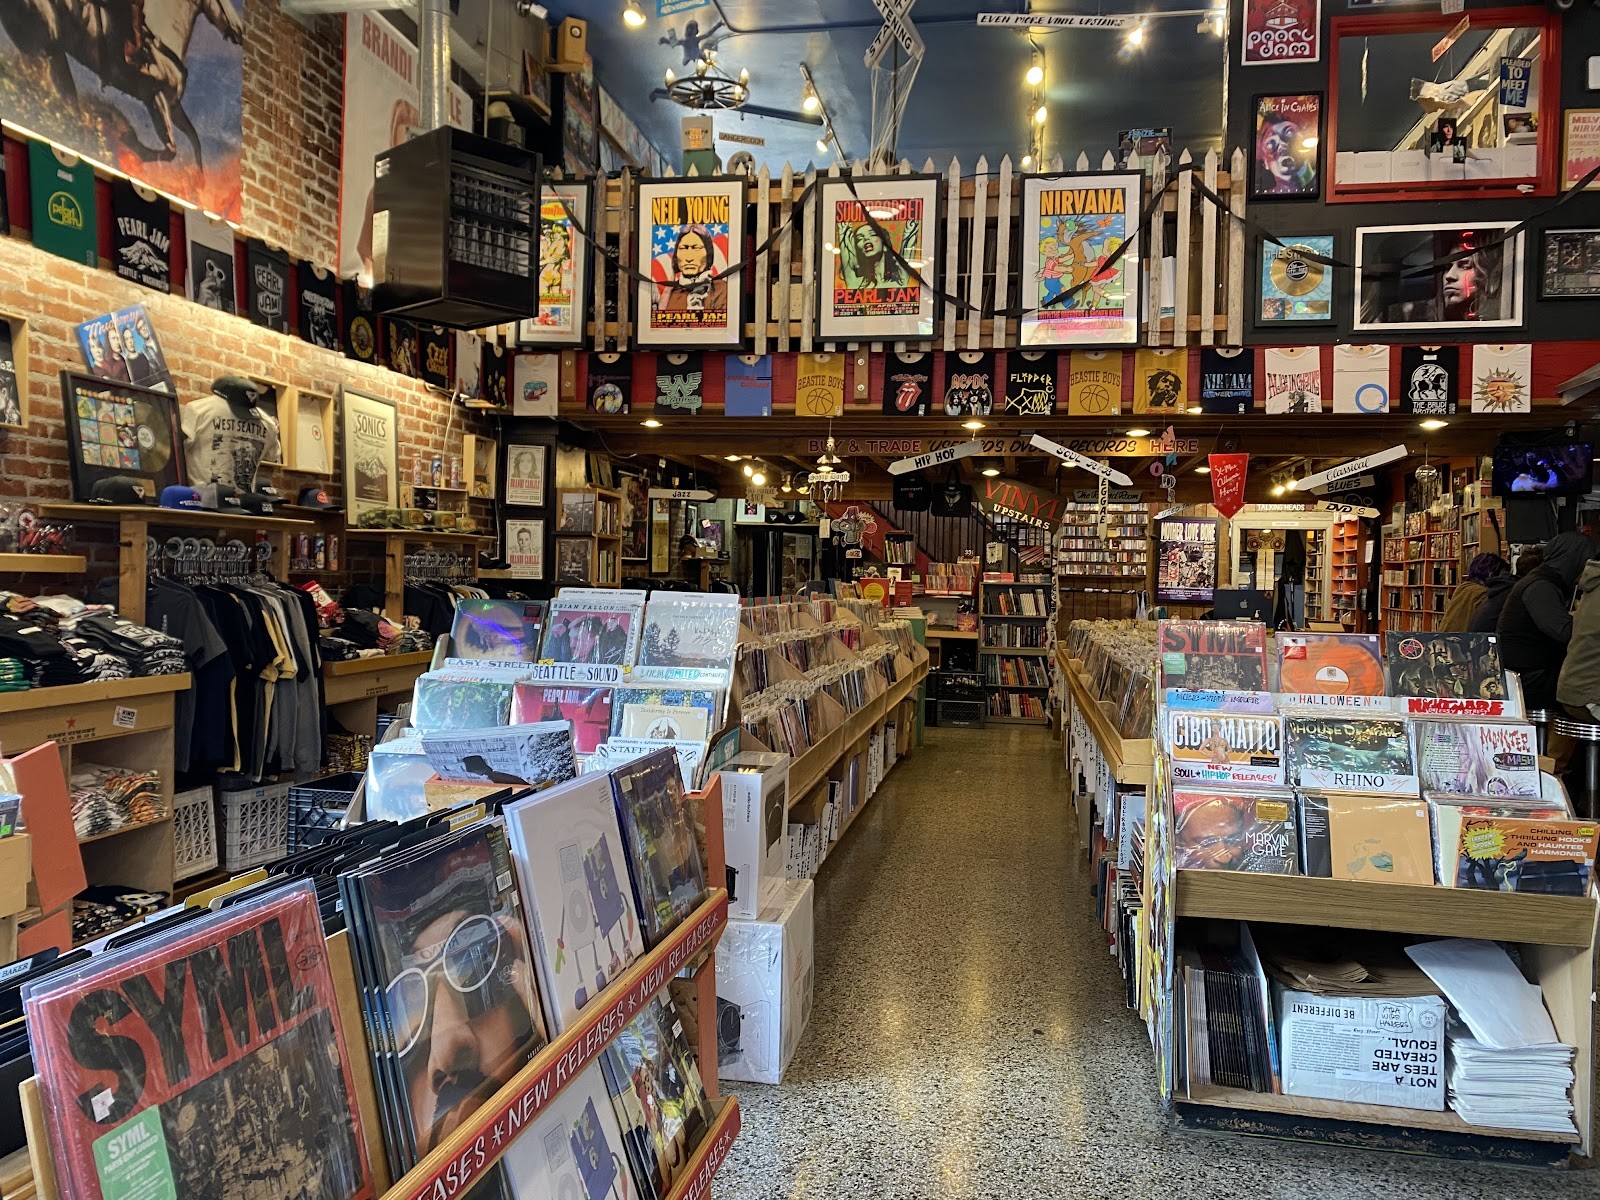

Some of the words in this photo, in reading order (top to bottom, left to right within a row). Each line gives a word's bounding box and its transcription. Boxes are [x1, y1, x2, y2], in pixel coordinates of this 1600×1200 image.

[1014, 16, 1044, 24] MORE
[1048, 17, 1075, 25] VINYL
[1078, 18, 1126, 26] UPSTAIRS
[362, 13, 412, 85] BRANDI
[1508, 66, 1523, 80] TO
[1502, 80, 1526, 90] MEET
[1505, 90, 1524, 104] ME
[1041, 188, 1124, 214] NIRVANA
[652, 198, 681, 225] NEIL
[686, 196, 729, 225] YOUNG
[117, 216, 148, 241] PEARL
[150, 228, 170, 253] JAM
[256, 267, 282, 292] PEARL
[259, 296, 280, 311] JAM
[834, 288, 882, 304] PEARL
[886, 287, 920, 302] JAM
[798, 375, 826, 391] BEASTIE
[828, 374, 845, 391] BOYS
[952, 374, 988, 390] AC/DC
[1010, 372, 1052, 386] FLIPPER
[1070, 370, 1100, 386] BEASTIE
[1102, 370, 1121, 386] BOYS
[1204, 374, 1252, 390] NIRVANA
[212, 418, 235, 431] WEST
[236, 418, 268, 439] SEATTLE
[356, 413, 386, 438] SONICS
[850, 440, 861, 453] &
[866, 440, 922, 453] TRADE
[1069, 440, 1138, 454] RECORDS
[1150, 438, 1199, 454] HERE
[914, 456, 931, 468] HIP
[936, 448, 955, 463] HOP
[1056, 446, 1081, 463] SOUL
[1326, 457, 1370, 482] Classical
[1216, 472, 1240, 487] Albums
[1327, 478, 1362, 492] BLUES
[1100, 460, 1108, 524] EGGAE
[984, 479, 1064, 523] VINYL
[1326, 502, 1366, 516] DVD'S
[992, 504, 1050, 530] UPSTAIRS
[1184, 522, 1200, 540] LOVE
[1164, 626, 1256, 653] SYML
[448, 659, 482, 667] EASY
[490, 660, 532, 670] STREET
[532, 665, 576, 681] SEATTLE
[586, 668, 618, 682] SOUND
[543, 688, 564, 702] PEARL
[565, 690, 580, 704] JAM
[1300, 694, 1372, 707] HALLOWEEN
[1408, 698, 1504, 716] NIGHTMARE
[1174, 715, 1212, 747] CIBO
[1220, 718, 1276, 752] MATTO
[1297, 724, 1342, 735] HOUSE
[609, 746, 646, 754] STAFF
[1206, 764, 1232, 772] NEW
[1507, 755, 1535, 766] MASH
[1174, 767, 1195, 778] SOUL
[1334, 772, 1384, 788] RHINO
[1245, 832, 1289, 846] MARVIN
[1530, 828, 1574, 836] CHILLING,
[1252, 843, 1288, 858] GAYE
[1530, 849, 1588, 858] HARMONIES
[640, 964, 666, 996] NEW
[668, 914, 712, 968] RELEASES
[1, 962, 30, 978] BAKER
[1292, 1003, 1340, 1018] DIFFERENT
[1344, 1010, 1354, 1020] BE
[67, 917, 317, 1125] SYML
[1387, 1036, 1438, 1050] EQUAL.
[1374, 1050, 1438, 1062] CREATED
[508, 1082, 551, 1138] NEW
[554, 1000, 624, 1088] RELEASES
[1372, 1061, 1398, 1072] ARE
[1404, 1065, 1438, 1076] TEES
[1410, 1078, 1437, 1089] NOT
[108, 1121, 150, 1160] SYML
